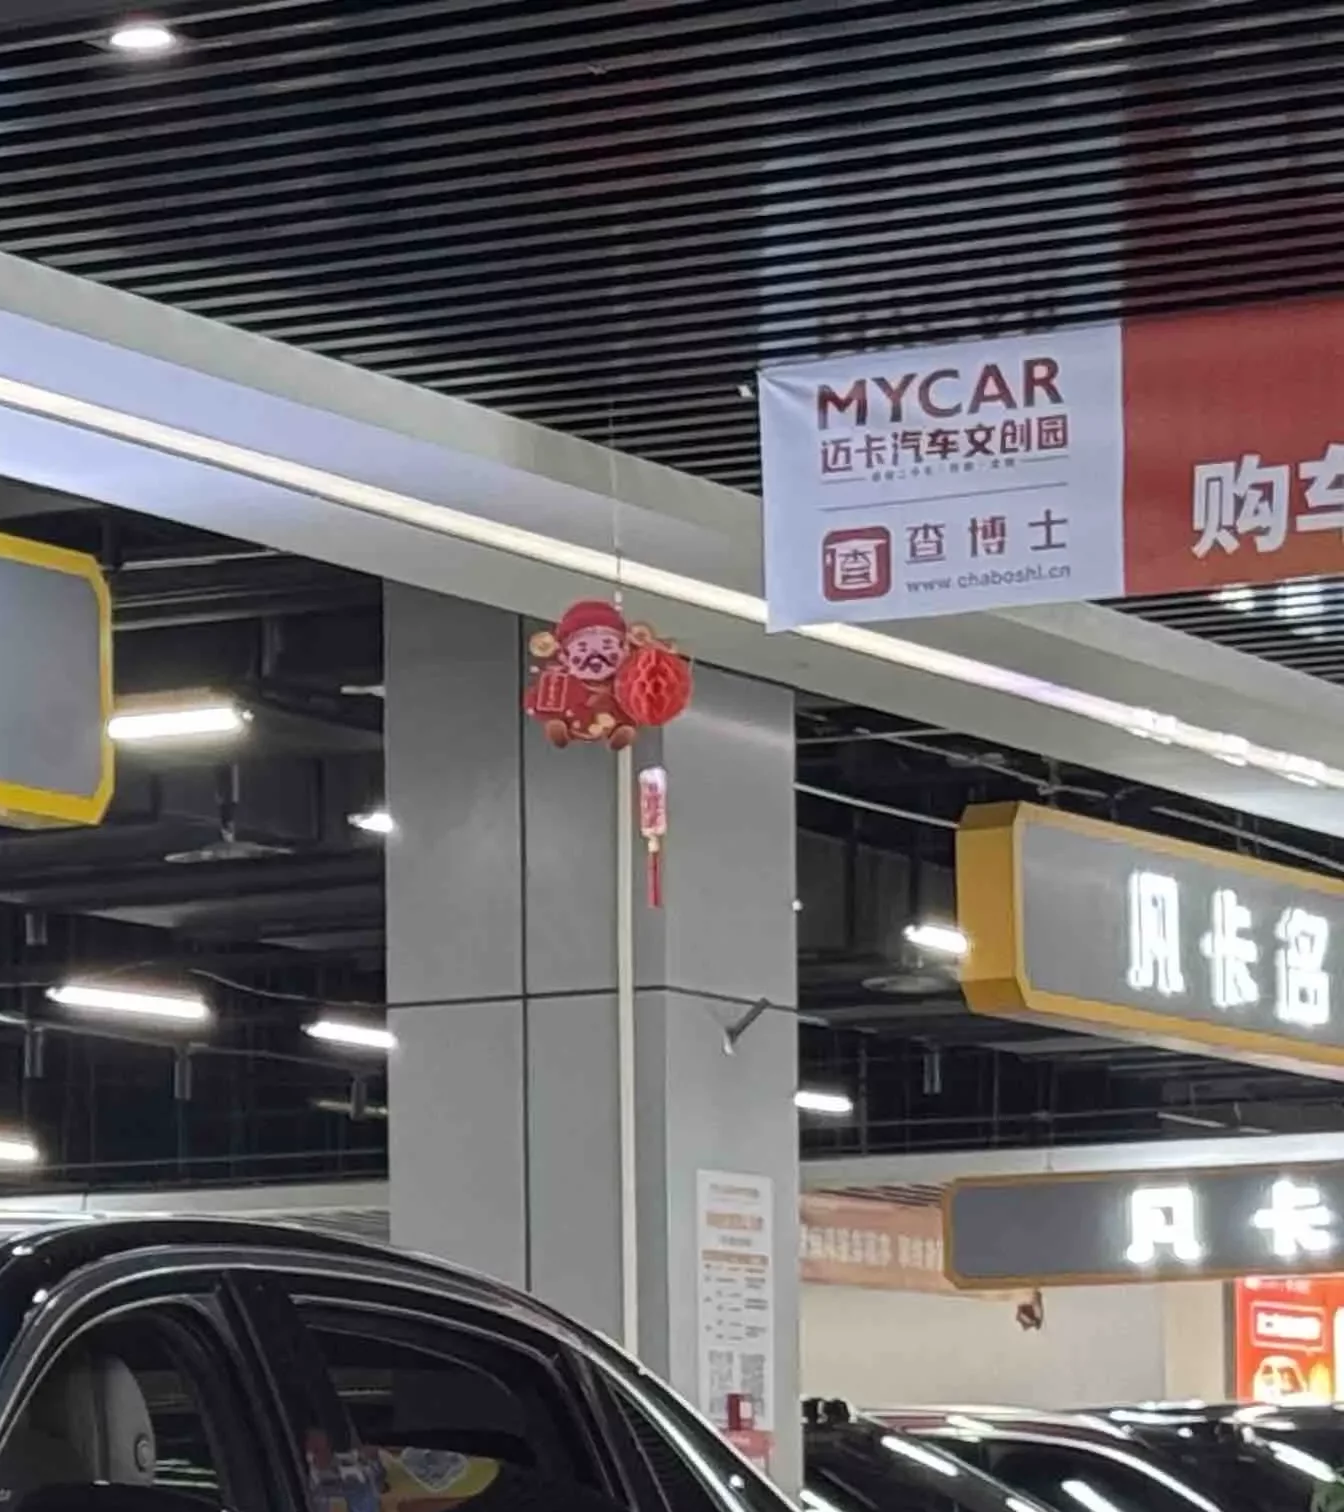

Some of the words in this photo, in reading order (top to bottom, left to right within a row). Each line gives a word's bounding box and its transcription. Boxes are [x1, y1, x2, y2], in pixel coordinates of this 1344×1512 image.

[817, 357, 1065, 430] MYCAR
[820, 413, 1069, 474] 迈卡汽车文创园
[905, 508, 1068, 565] 查博士
[905, 564, 1072, 593] www.chaboshi.cn
